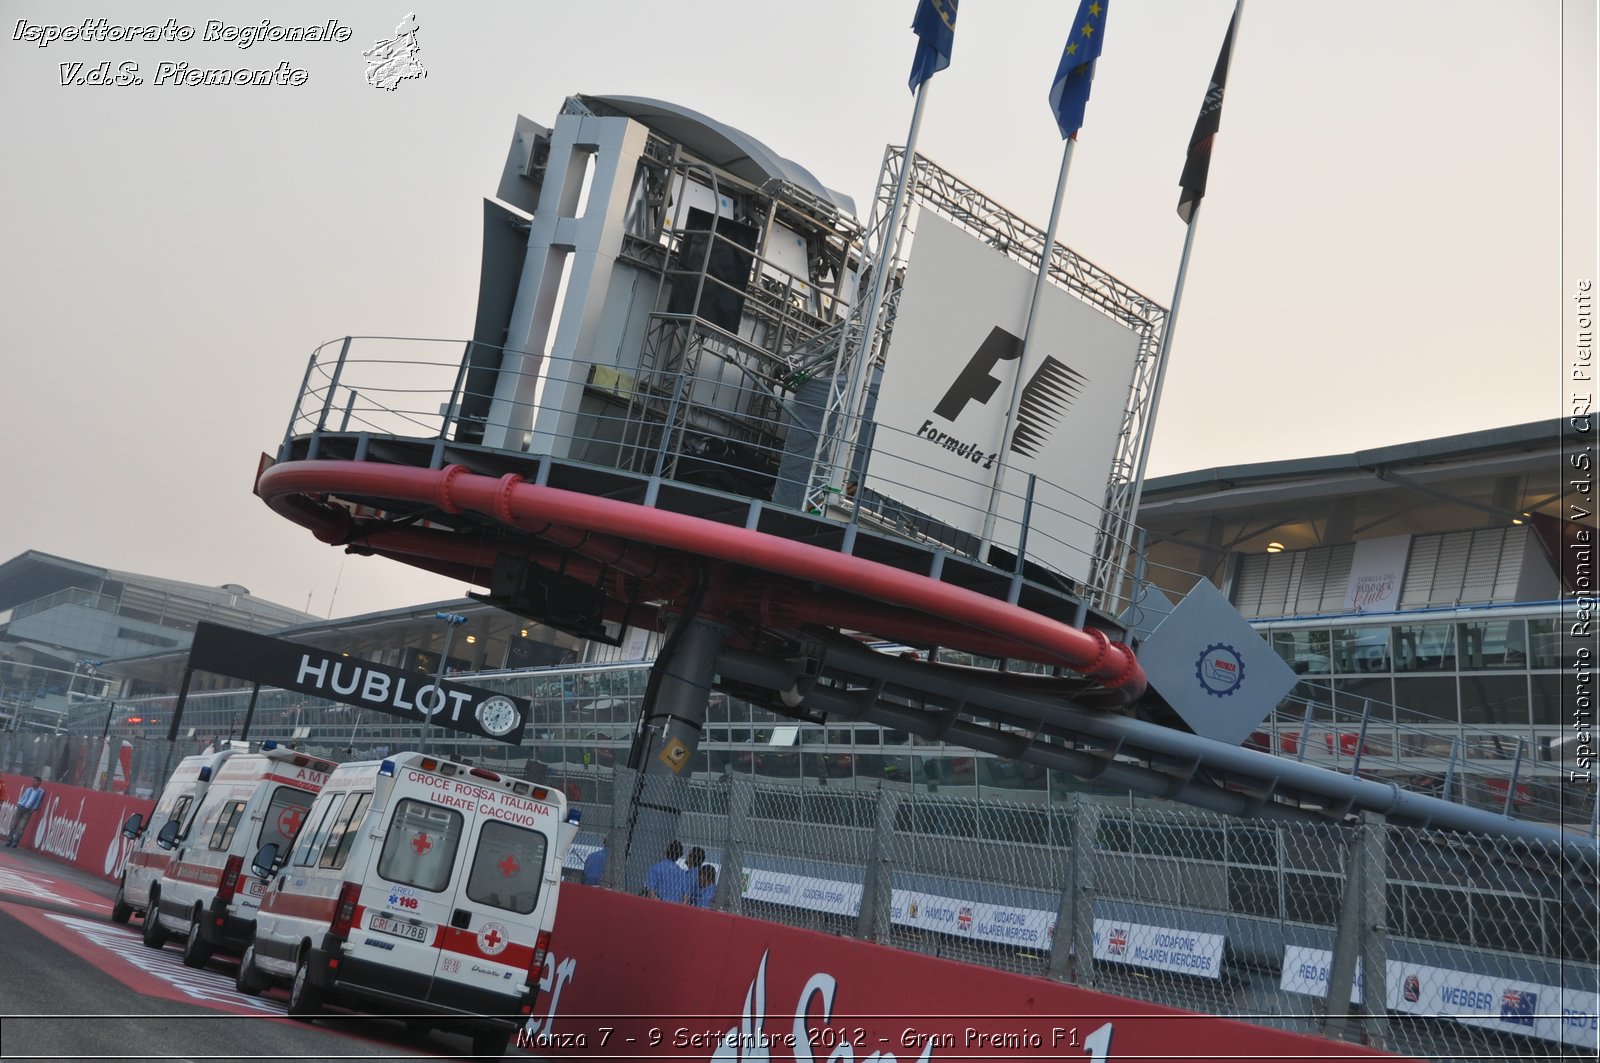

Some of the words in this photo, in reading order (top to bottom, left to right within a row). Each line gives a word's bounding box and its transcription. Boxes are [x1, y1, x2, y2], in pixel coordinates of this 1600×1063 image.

[916, 419, 984, 464] Formula
[982, 453, 998, 470] 1
[1215, 659, 1236, 672] MONZA
[296, 654, 472, 721] HUBLOT
[408, 771, 451, 790] CROCE
[455, 783, 496, 802] ROSSA
[500, 795, 549, 816] ITALIANA
[431, 792, 475, 811] LURATE
[480, 804, 535, 827] CACCIVIO
[391, 885, 415, 896] AREU
[399, 896, 418, 909] 118
[925, 907, 954, 922] HAMILTON
[993, 911, 1025, 926] VODAFONE
[372, 917, 388, 930] CRI
[978, 922, 1004, 938] McLAREN
[1005, 927, 1038, 942] MERCEDES
[1155, 934, 1195, 950] VODAFONE
[1134, 946, 1168, 964] McLAREN
[1169, 952, 1211, 971] MERCEDES
[1299, 964, 1317, 980] RED
[1442, 986, 1492, 1010] WEBBER
